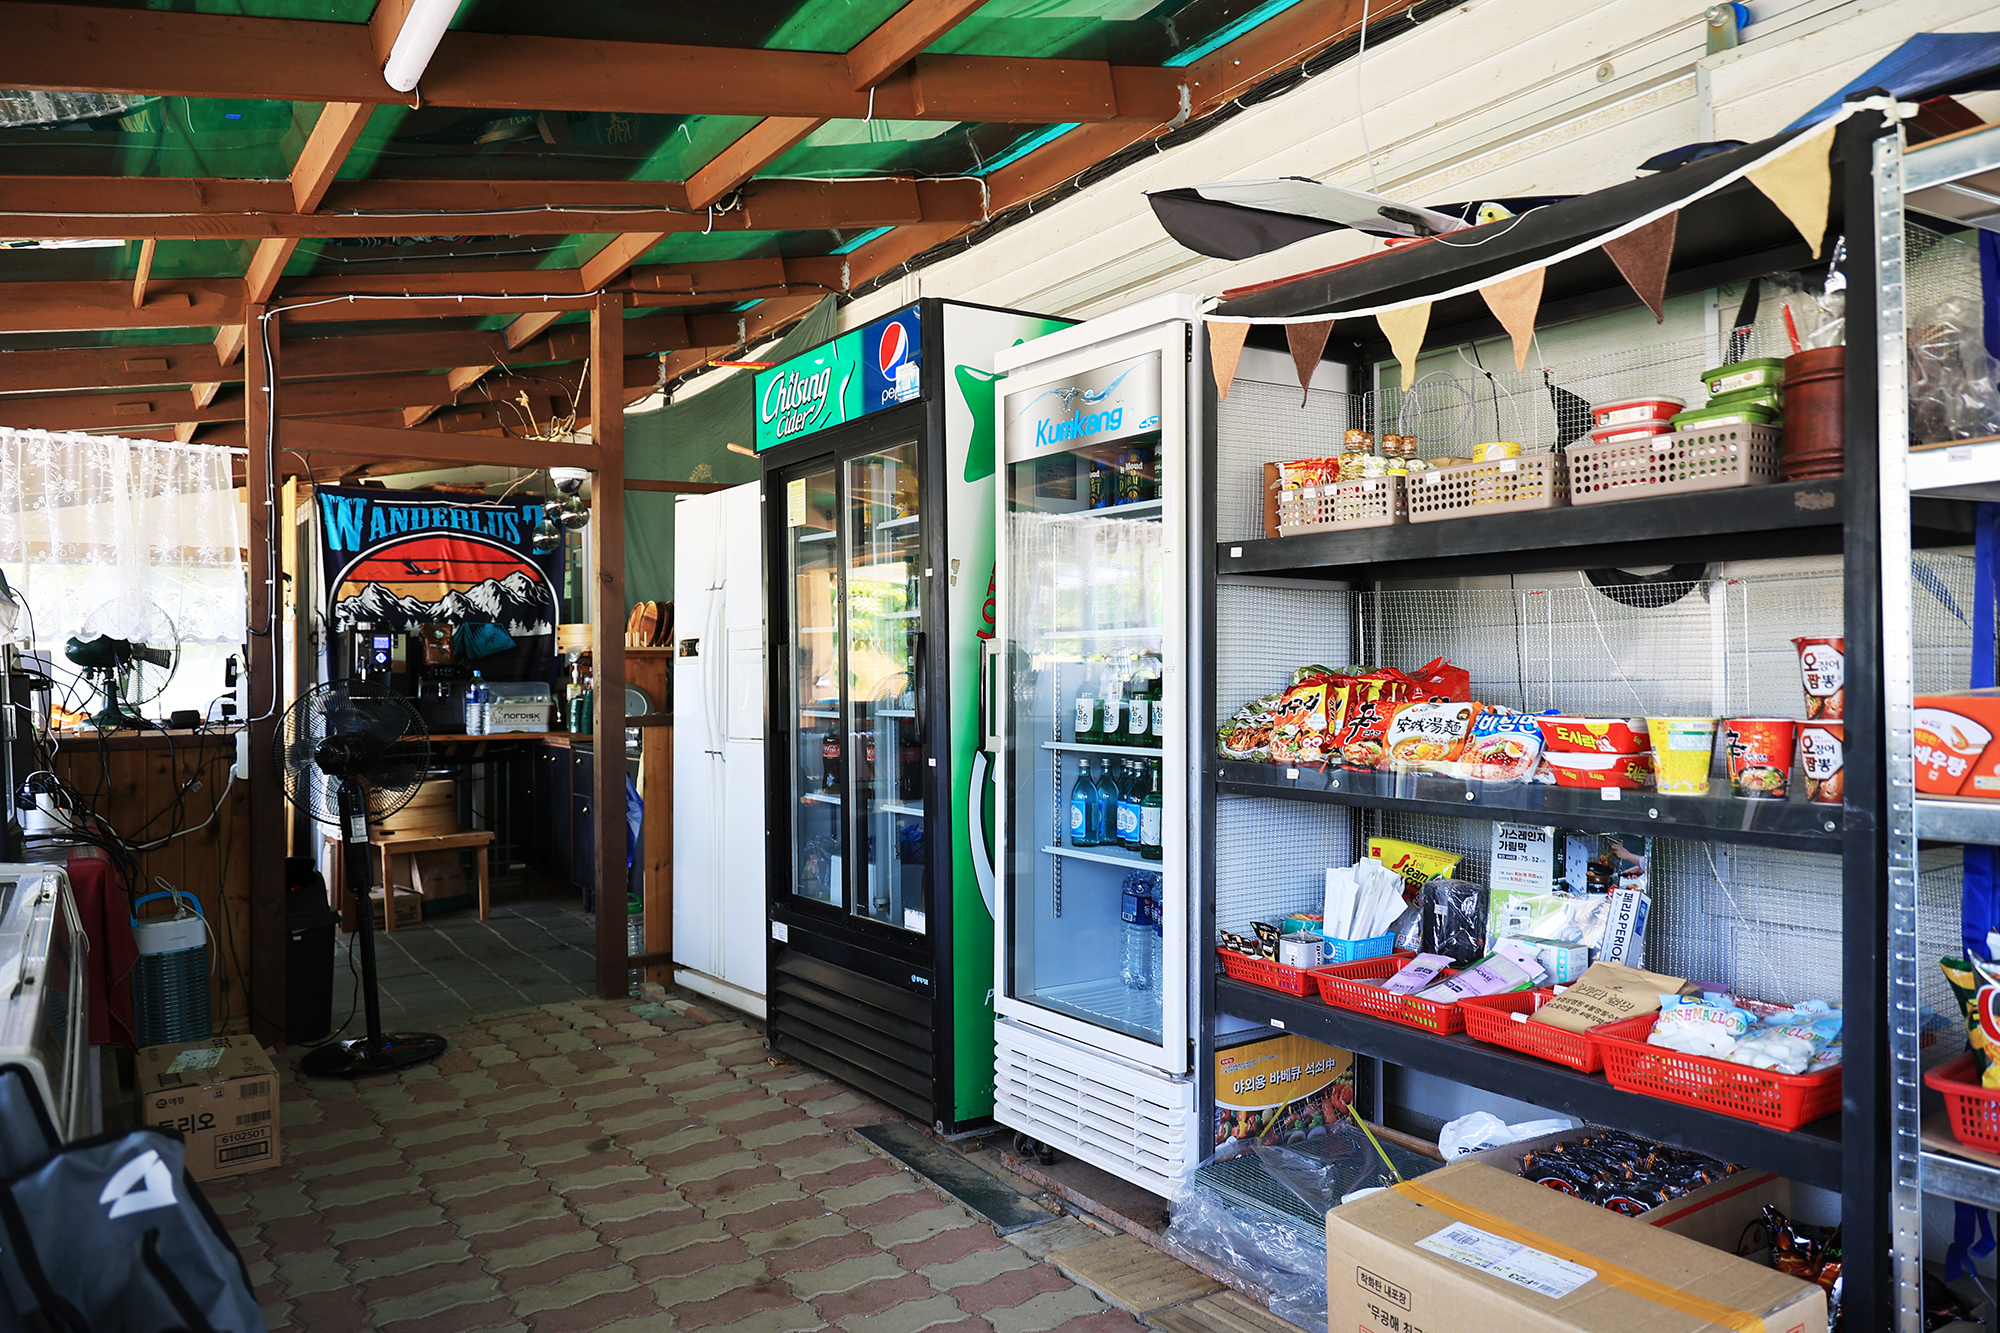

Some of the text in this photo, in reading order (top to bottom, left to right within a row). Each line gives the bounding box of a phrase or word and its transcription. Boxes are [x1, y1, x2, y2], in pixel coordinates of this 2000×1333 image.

[762, 366, 832, 425] Chilsung
[776, 403, 816, 439] Cider
[1035, 407, 1123, 447] Kumkang
[1803, 652, 1840, 671] 오징어
[1807, 674, 1837, 689] 짬뽕
[1556, 726, 1598, 750] 도시락
[1802, 735, 1835, 755] 오징어
[1805, 756, 1832, 773] 짬뽕
[1499, 828, 1546, 843] 가스레인지
[1498, 840, 1528, 853] 가림막
[1233, 1074, 1266, 1094] 야외용
[1269, 1065, 1302, 1085] 바베큐
[221, 1128, 265, 1144] 6102501
[1360, 1272, 1407, 1305] 착화탄 내포장
